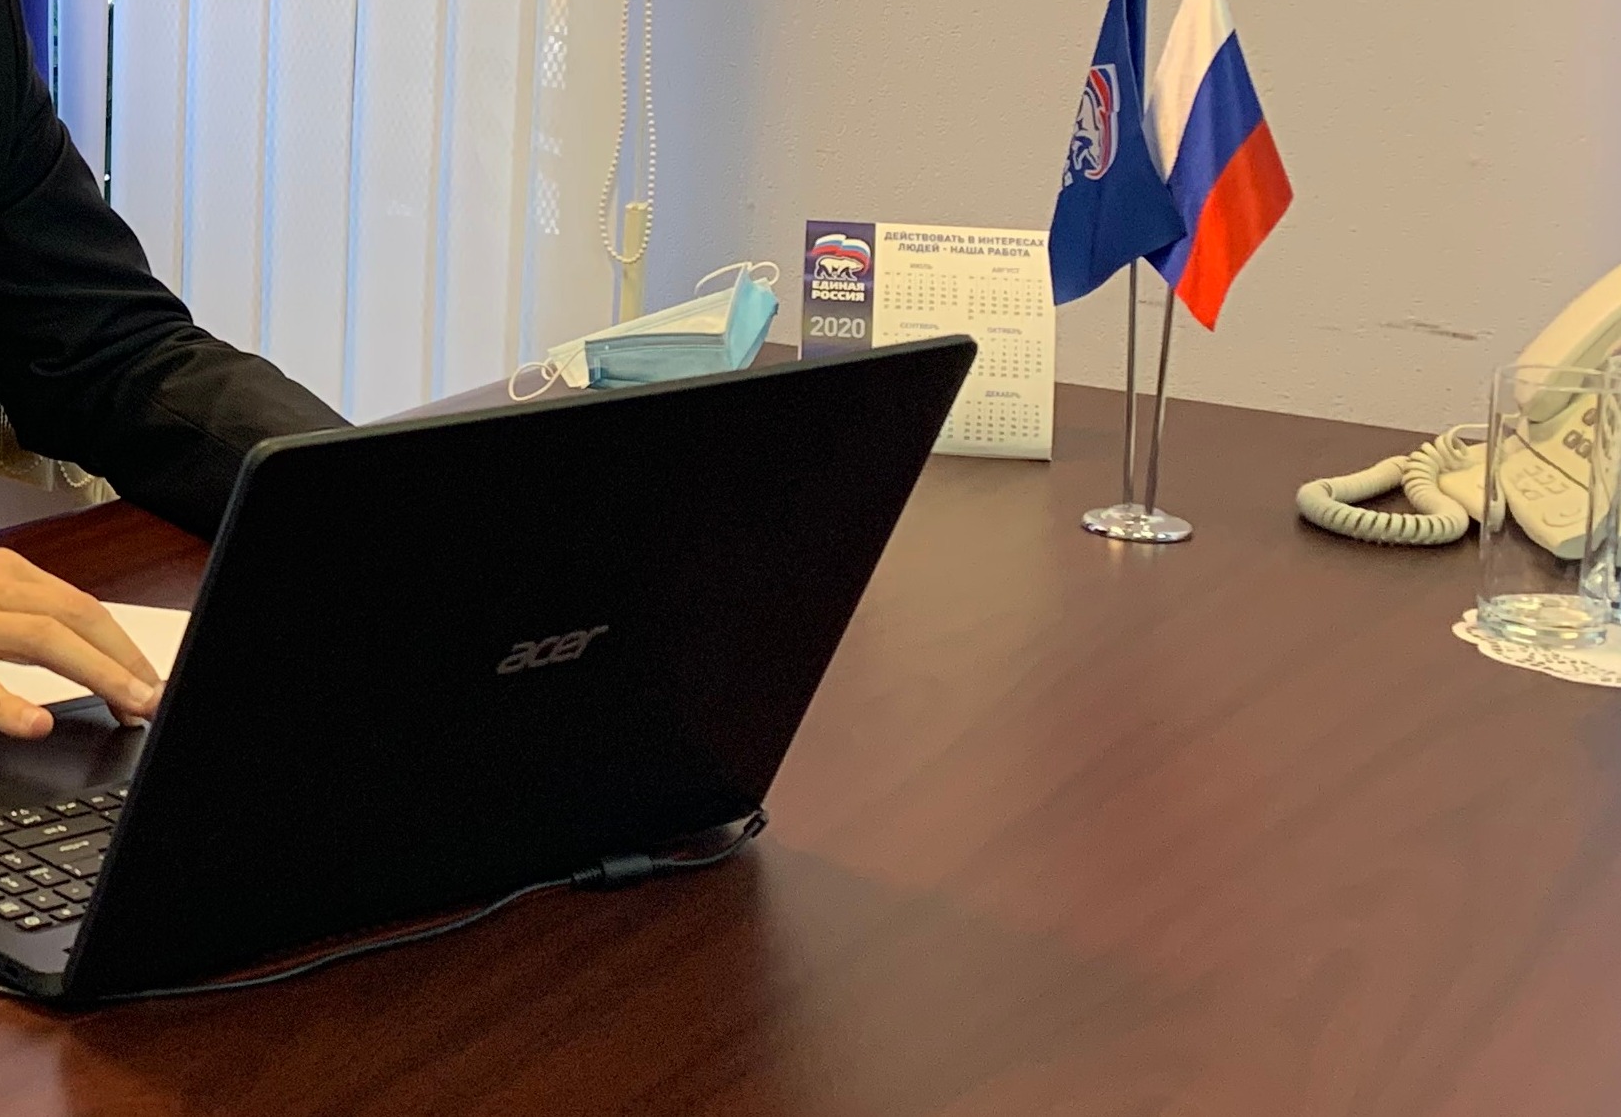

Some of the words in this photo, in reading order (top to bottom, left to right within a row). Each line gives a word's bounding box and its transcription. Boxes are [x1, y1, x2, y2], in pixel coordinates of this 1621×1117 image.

[884, 231, 965, 244] ДЕЙСТВОВАТЬ
[968, 235, 975, 244] В
[978, 236, 1045, 247] ИНТЕРЕСАХ
[898, 242, 940, 253] ЛЮДЕЙ
[950, 246, 985, 256] НАША
[987, 248, 1031, 257] РАБОТА
[812, 280, 865, 292] ЕДИНАЯ
[811, 289, 865, 302] РОССИЯ
[810, 316, 866, 339] 2020
[496, 624, 610, 675] acer
